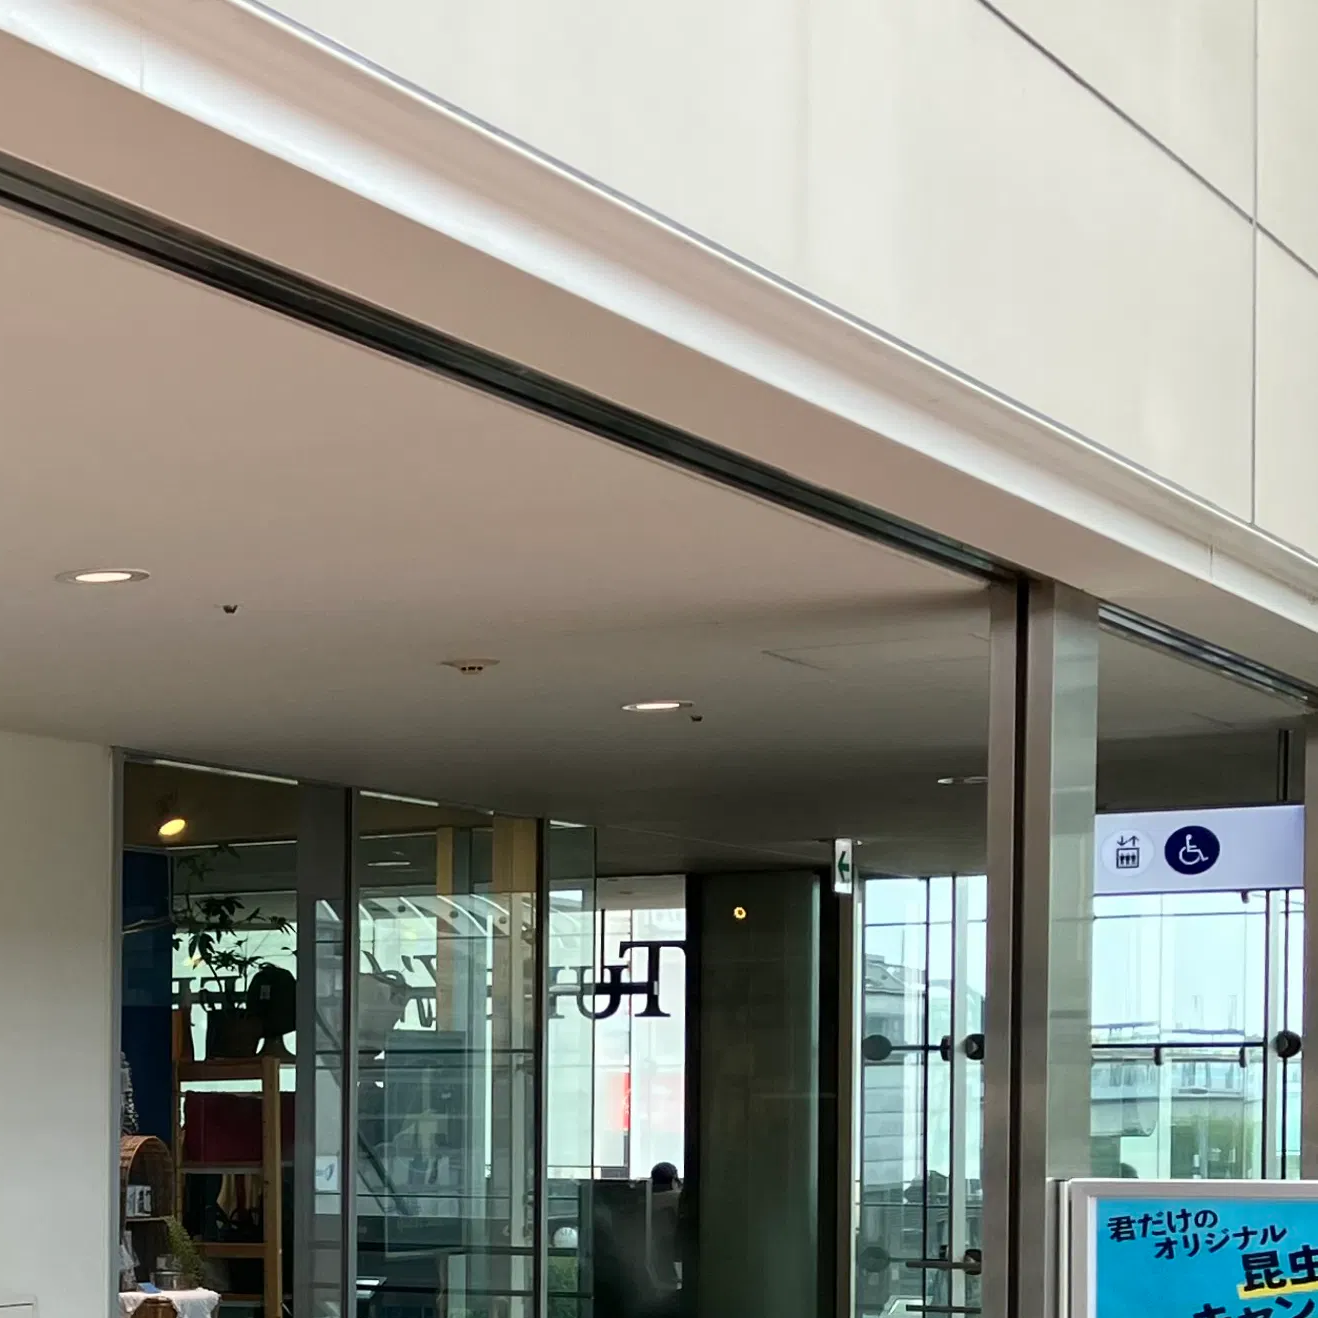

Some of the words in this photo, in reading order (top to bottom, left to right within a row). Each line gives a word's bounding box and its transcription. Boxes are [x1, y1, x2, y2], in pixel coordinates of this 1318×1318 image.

[1107, 1208, 1218, 1242] 君だけの
[1154, 1223, 1288, 1260] オリジナル
